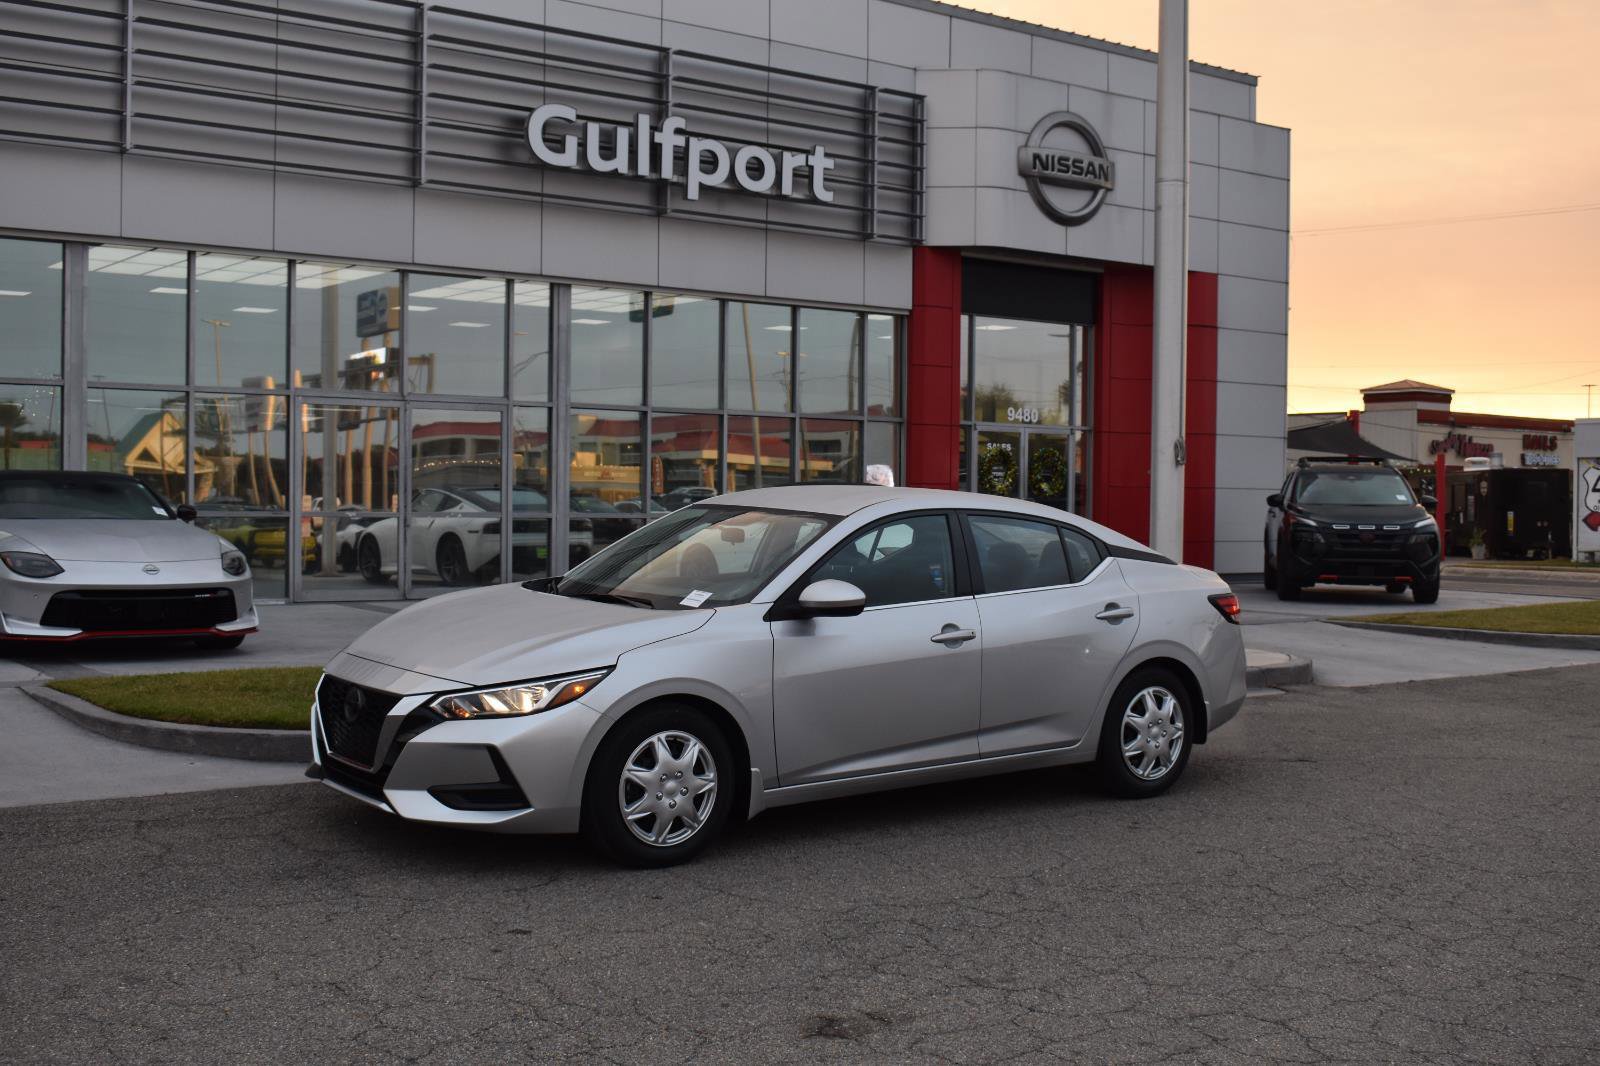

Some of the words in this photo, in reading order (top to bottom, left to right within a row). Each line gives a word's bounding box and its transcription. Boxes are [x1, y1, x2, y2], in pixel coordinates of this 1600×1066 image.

[526, 104, 835, 201] Gulfport
[1032, 152, 1109, 182] NISSAN
[1007, 407, 1039, 422] 9480
